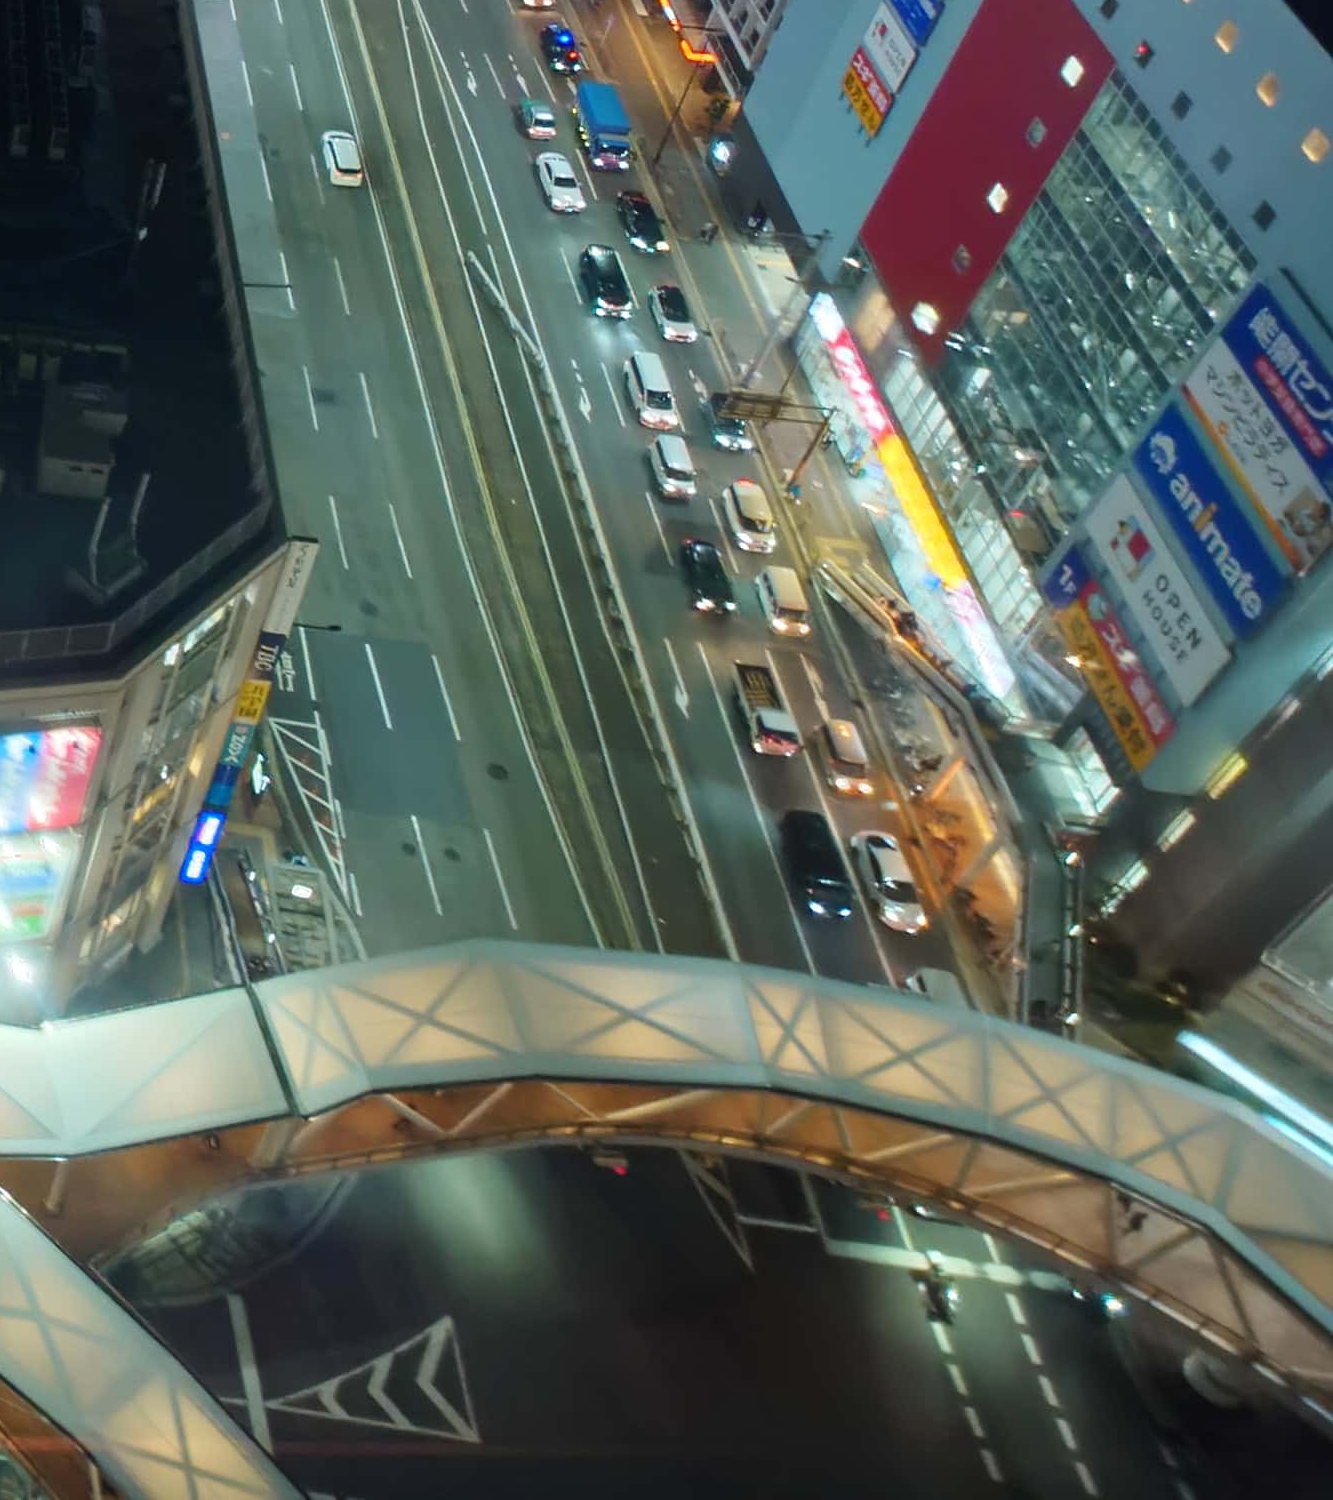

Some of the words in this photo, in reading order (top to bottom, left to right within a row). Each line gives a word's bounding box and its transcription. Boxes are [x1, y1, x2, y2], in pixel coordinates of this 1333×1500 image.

[1167, 472, 1265, 620] animate
[1140, 588, 1188, 666] HOUSE
[1153, 572, 1205, 652] OPEN
[253, 644, 279, 670] TBC
